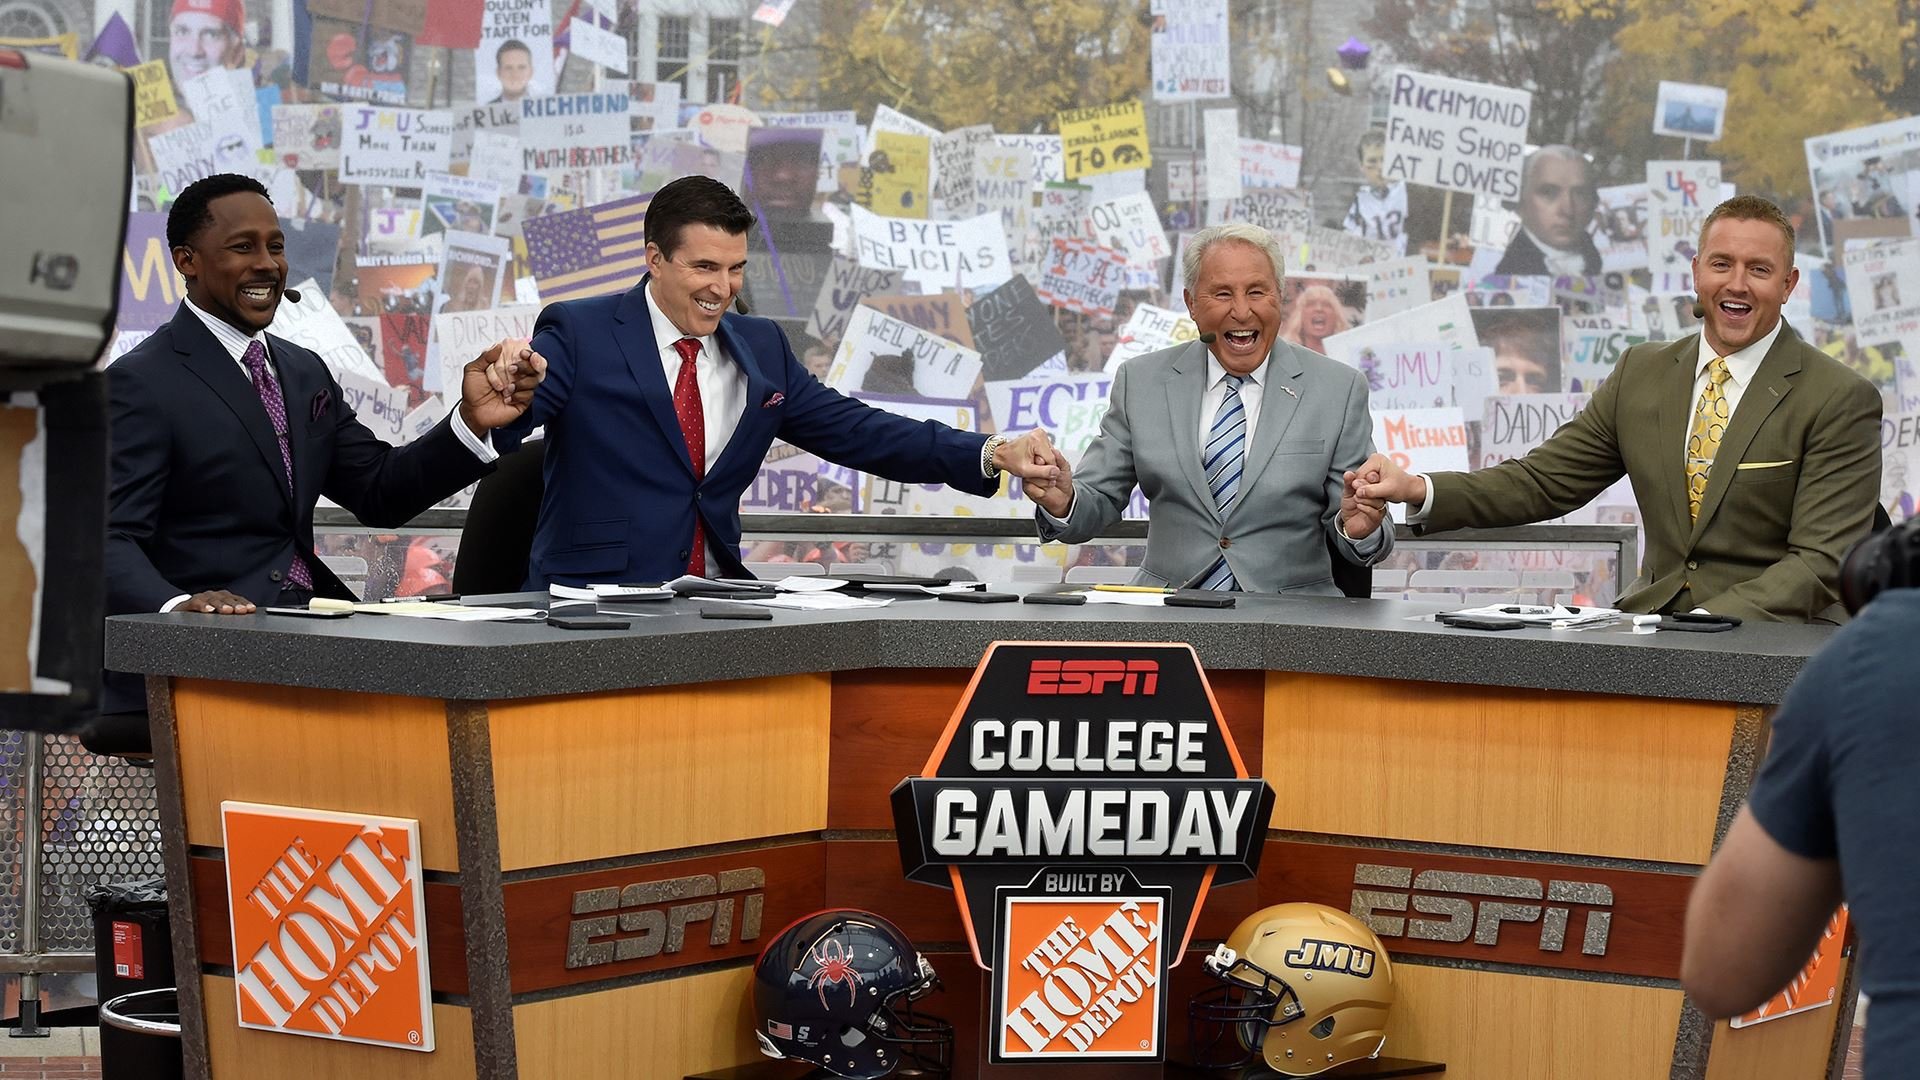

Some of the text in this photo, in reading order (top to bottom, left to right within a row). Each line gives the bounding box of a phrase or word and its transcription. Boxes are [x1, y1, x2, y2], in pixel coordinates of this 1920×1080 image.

[480, 0, 545, 12] OULDN'T
[494, 12, 530, 24] EVEN
[480, 24, 550, 39] TART FOR
[523, 93, 629, 119] RICHMOND
[1393, 73, 1526, 128] RICHMOND
[355, 109, 411, 132] JMU
[401, 136, 437, 151] THAN
[1390, 117, 1522, 163] FANS SHOP
[976, 179, 1027, 200] WANT
[1387, 153, 1520, 198] AT LOWES
[889, 221, 956, 246] BYE
[1092, 201, 1121, 231] OJ
[1660, 216, 1703, 237] DUK
[858, 234, 995, 273] FELICIAS
[452, 313, 537, 349] DURAN
[1141, 308, 1171, 331] THE
[911, 333, 947, 367] PUT
[1388, 351, 1441, 389] JMU
[1026, 659, 1159, 695] ESPN
[969, 718, 1208, 773] COLLEGE
[931, 787, 1254, 857] GAMEDAY
[246, 835, 323, 921] THE
[1045, 873, 1126, 893] BUILT BY
[237, 825, 413, 1028] HOME
[565, 867, 767, 970] ESPN
[1349, 862, 1614, 956] ESPN
[1021, 915, 1088, 979] THE
[1284, 938, 1376, 979] JMU
[309, 907, 417, 1036] DEPOT
[1005, 900, 1159, 1054] HOME
[1062, 955, 1158, 1054] DEPOT
